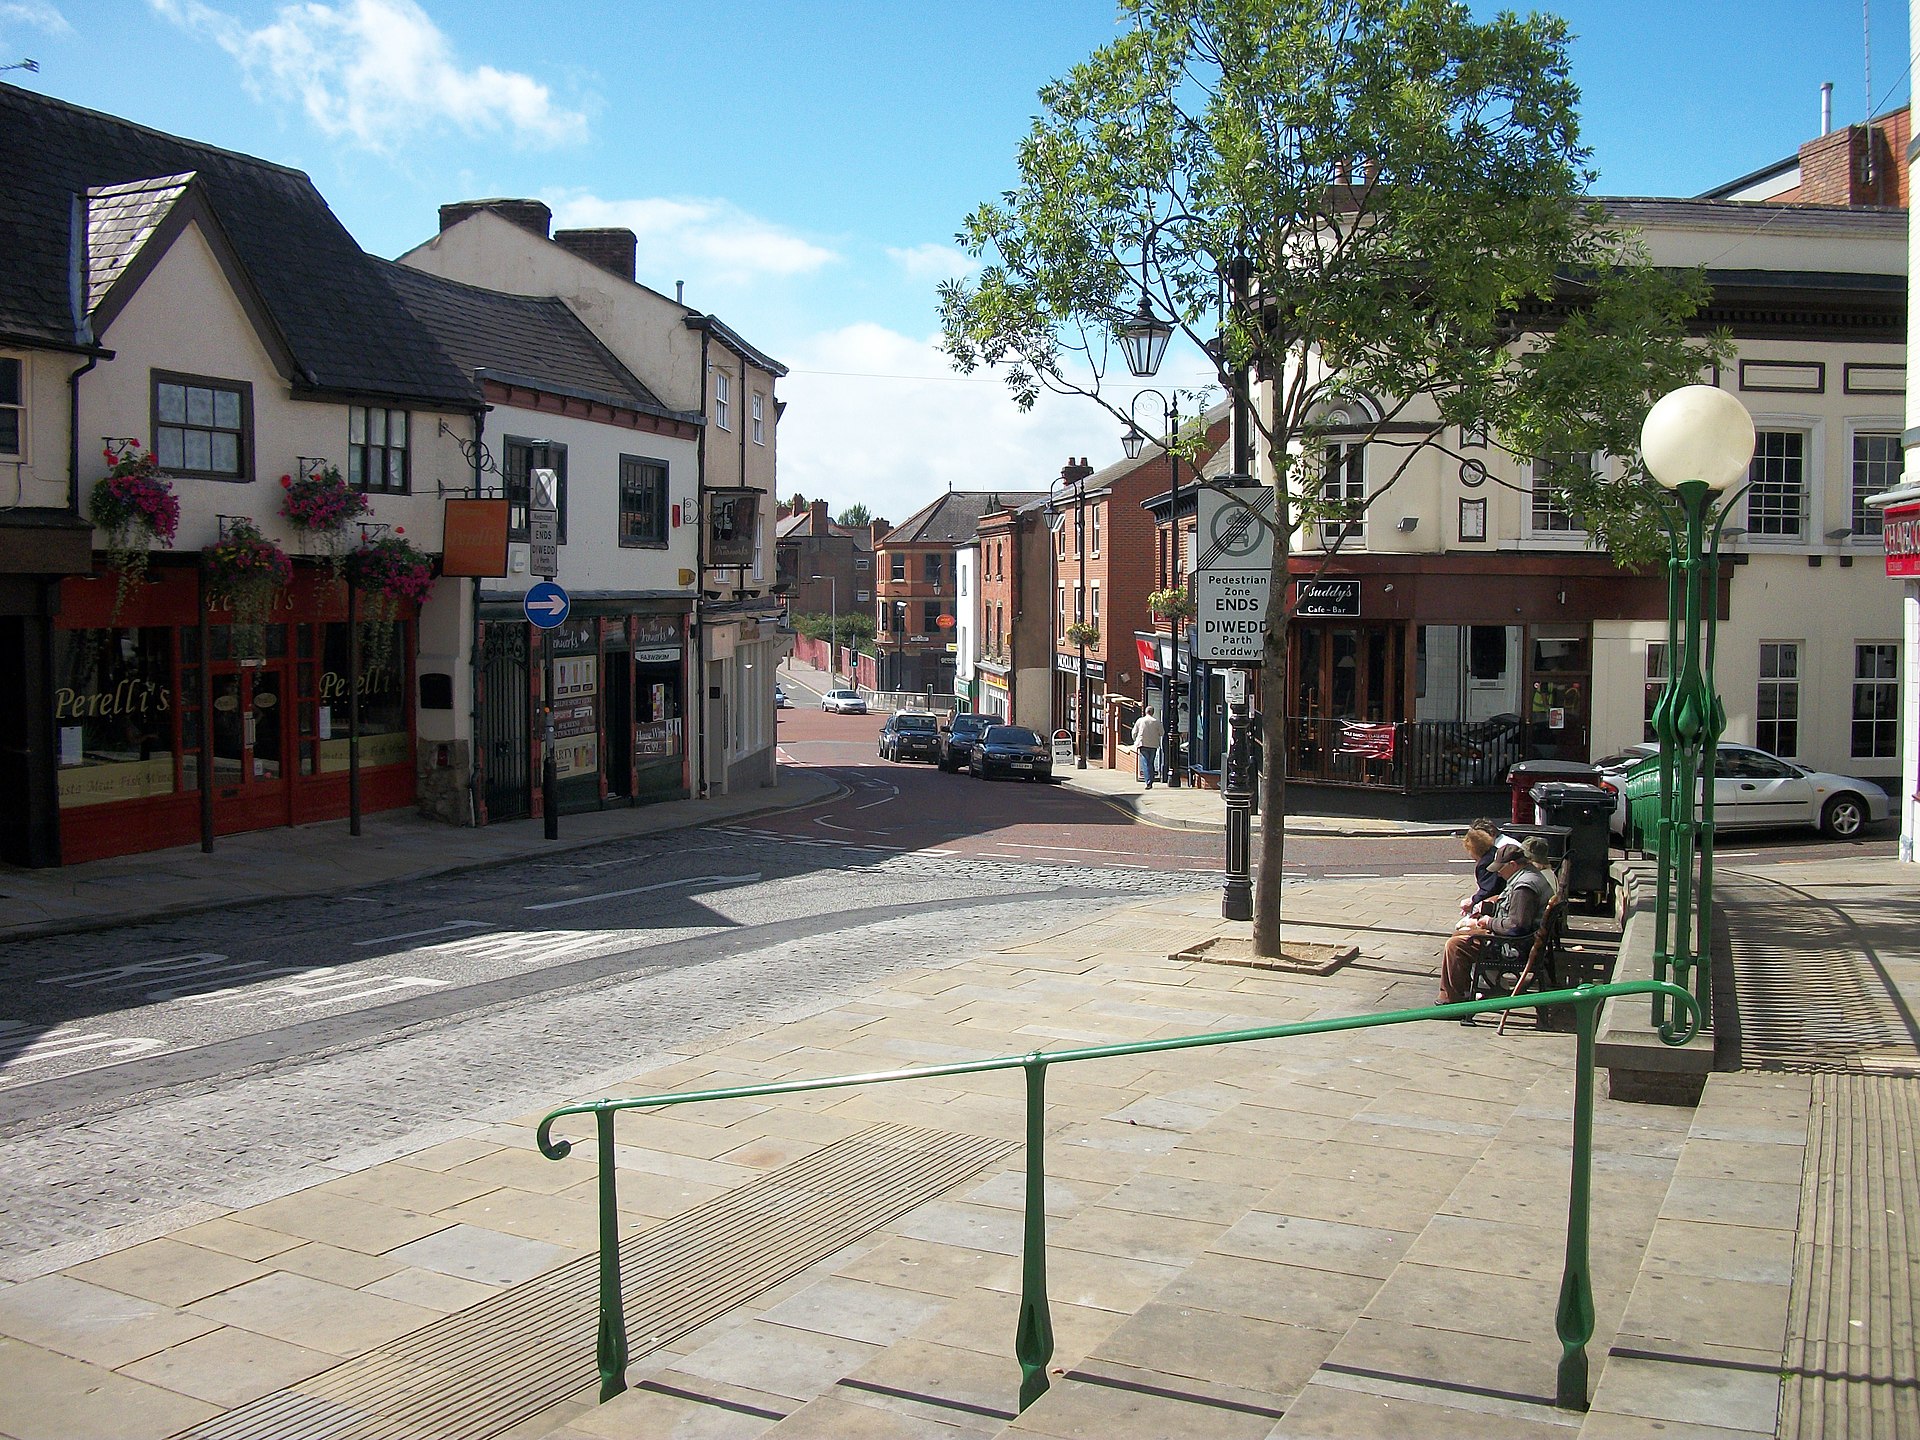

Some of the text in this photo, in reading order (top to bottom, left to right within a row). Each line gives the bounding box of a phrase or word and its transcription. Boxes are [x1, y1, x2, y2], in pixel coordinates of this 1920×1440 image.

[535, 530, 552, 540] ENDS
[532, 544, 556, 555] DIWEDD
[1208, 575, 1267, 585] Pedestrian
[1224, 586, 1251, 596] Zone
[1303, 584, 1352, 603] Buddy's
[1215, 598, 1259, 611] ENDS
[1307, 605, 1326, 613] Cafe
[1332, 605, 1347, 613] Bar
[1205, 620, 1266, 633] DIWEDD
[1222, 635, 1252, 644] Parth
[55, 678, 171, 719] Perelli's
